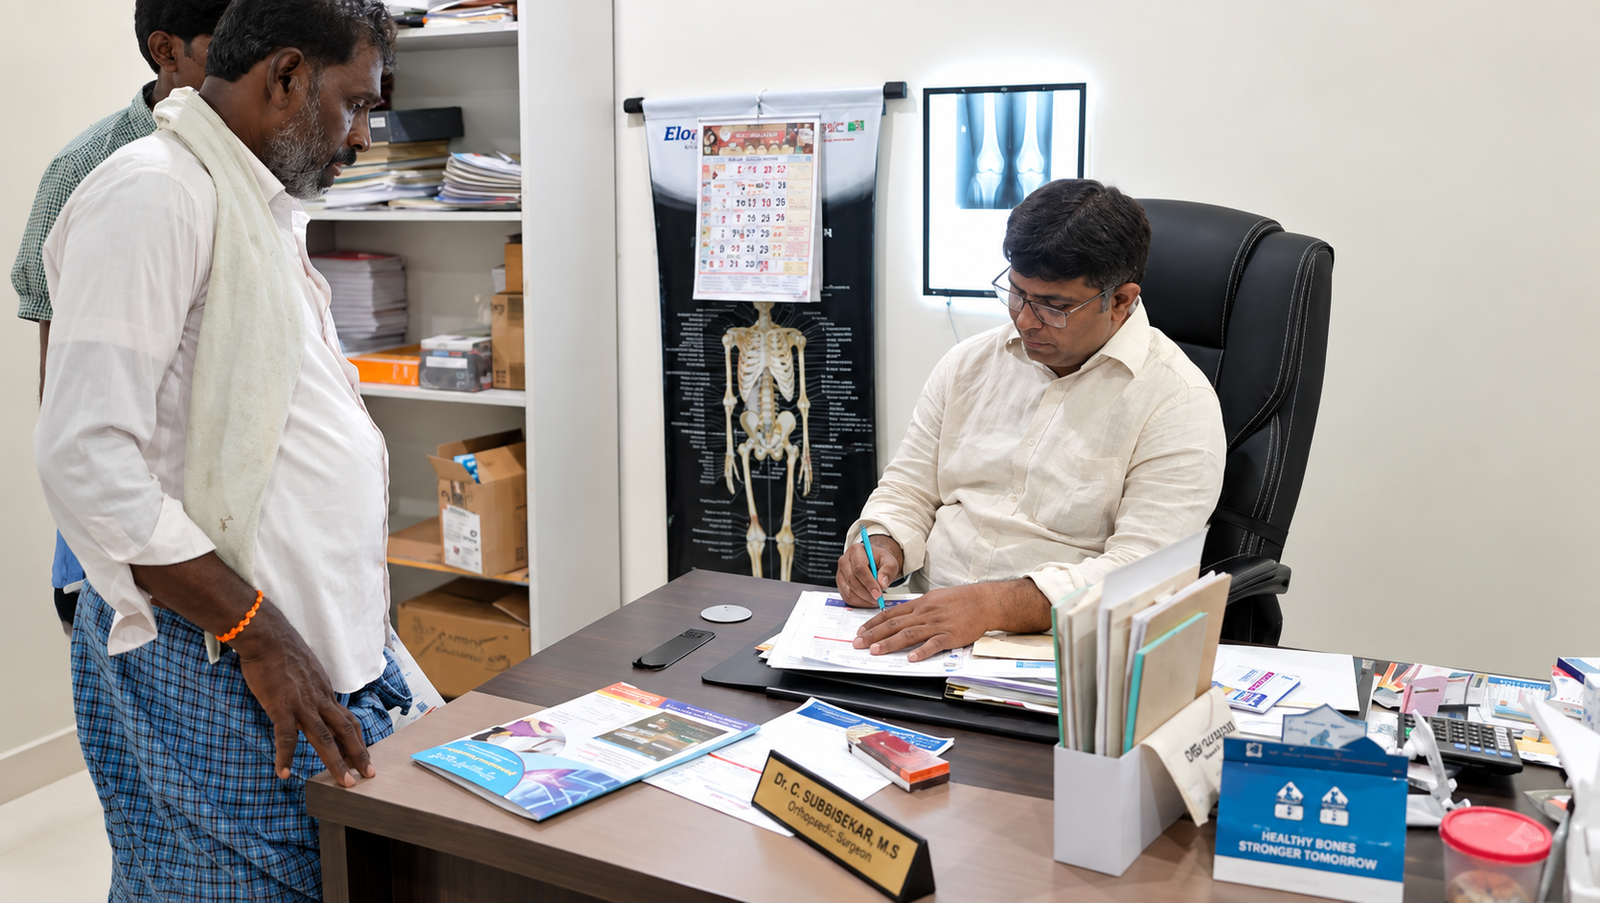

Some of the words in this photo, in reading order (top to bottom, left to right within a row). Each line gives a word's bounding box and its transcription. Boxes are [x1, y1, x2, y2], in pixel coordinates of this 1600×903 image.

[773, 771, 787, 791] Dr.
[789, 781, 800, 798] C.
[802, 789, 874, 847] SUBBISEKAR,
[876, 835, 900, 860] M.S
[835, 831, 873, 863] Surgeon
[1239, 840, 1302, 860] STRONGER
[1304, 850, 1378, 871] TOMORROW
[1262, 831, 1314, 848] HEALTHY
[1315, 838, 1357, 854] BONES
